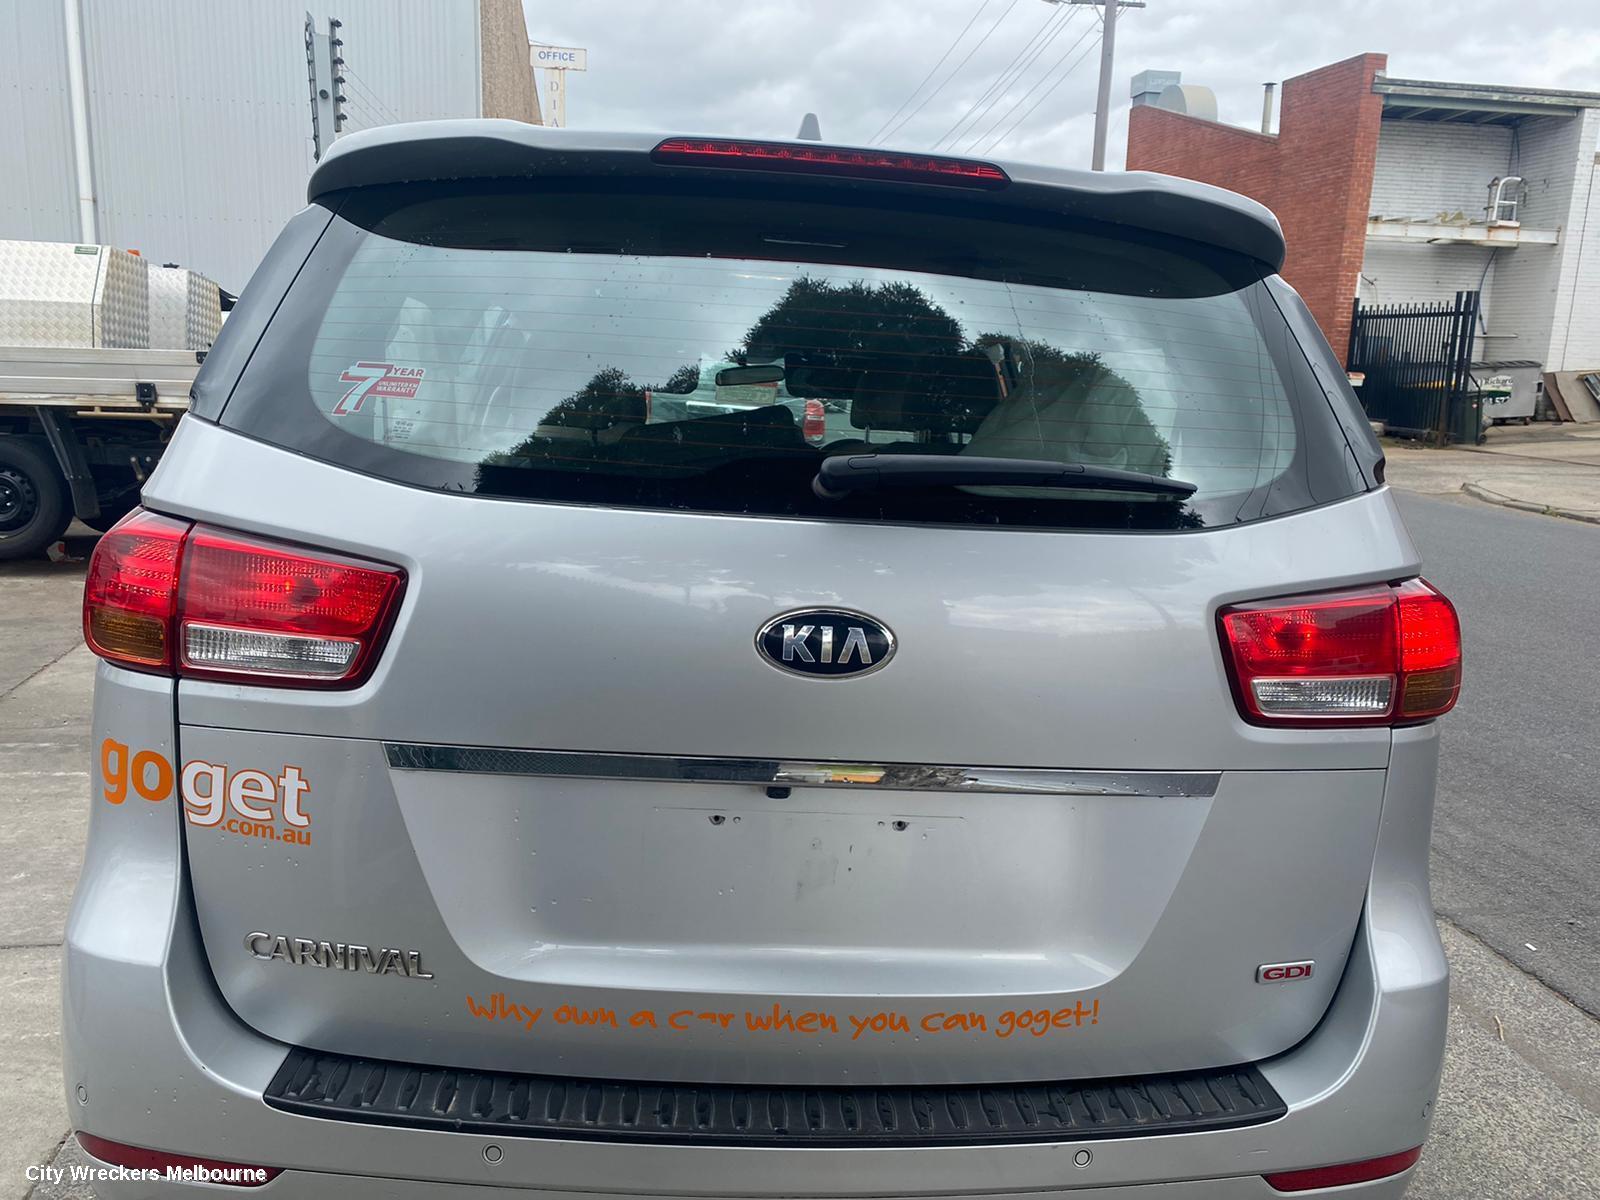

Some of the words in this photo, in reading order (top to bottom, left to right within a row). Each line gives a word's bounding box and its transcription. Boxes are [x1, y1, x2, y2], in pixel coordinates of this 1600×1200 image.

[538, 51, 575, 61] OFFICE
[332, 361, 394, 416] 7
[393, 367, 424, 377] YEAR
[782, 624, 872, 664] KIA
[220, 817, 311, 846] .com.au
[243, 931, 435, 980] CARNIVAL
[1263, 965, 1312, 980] GDI
[466, 993, 544, 1031] Why
[552, 1003, 620, 1029] own
[628, 1010, 658, 1029] a
[744, 1004, 840, 1033] when
[849, 1012, 911, 1040] you
[920, 1012, 988, 1033] can
[995, 1000, 1100, 1039] goget!
